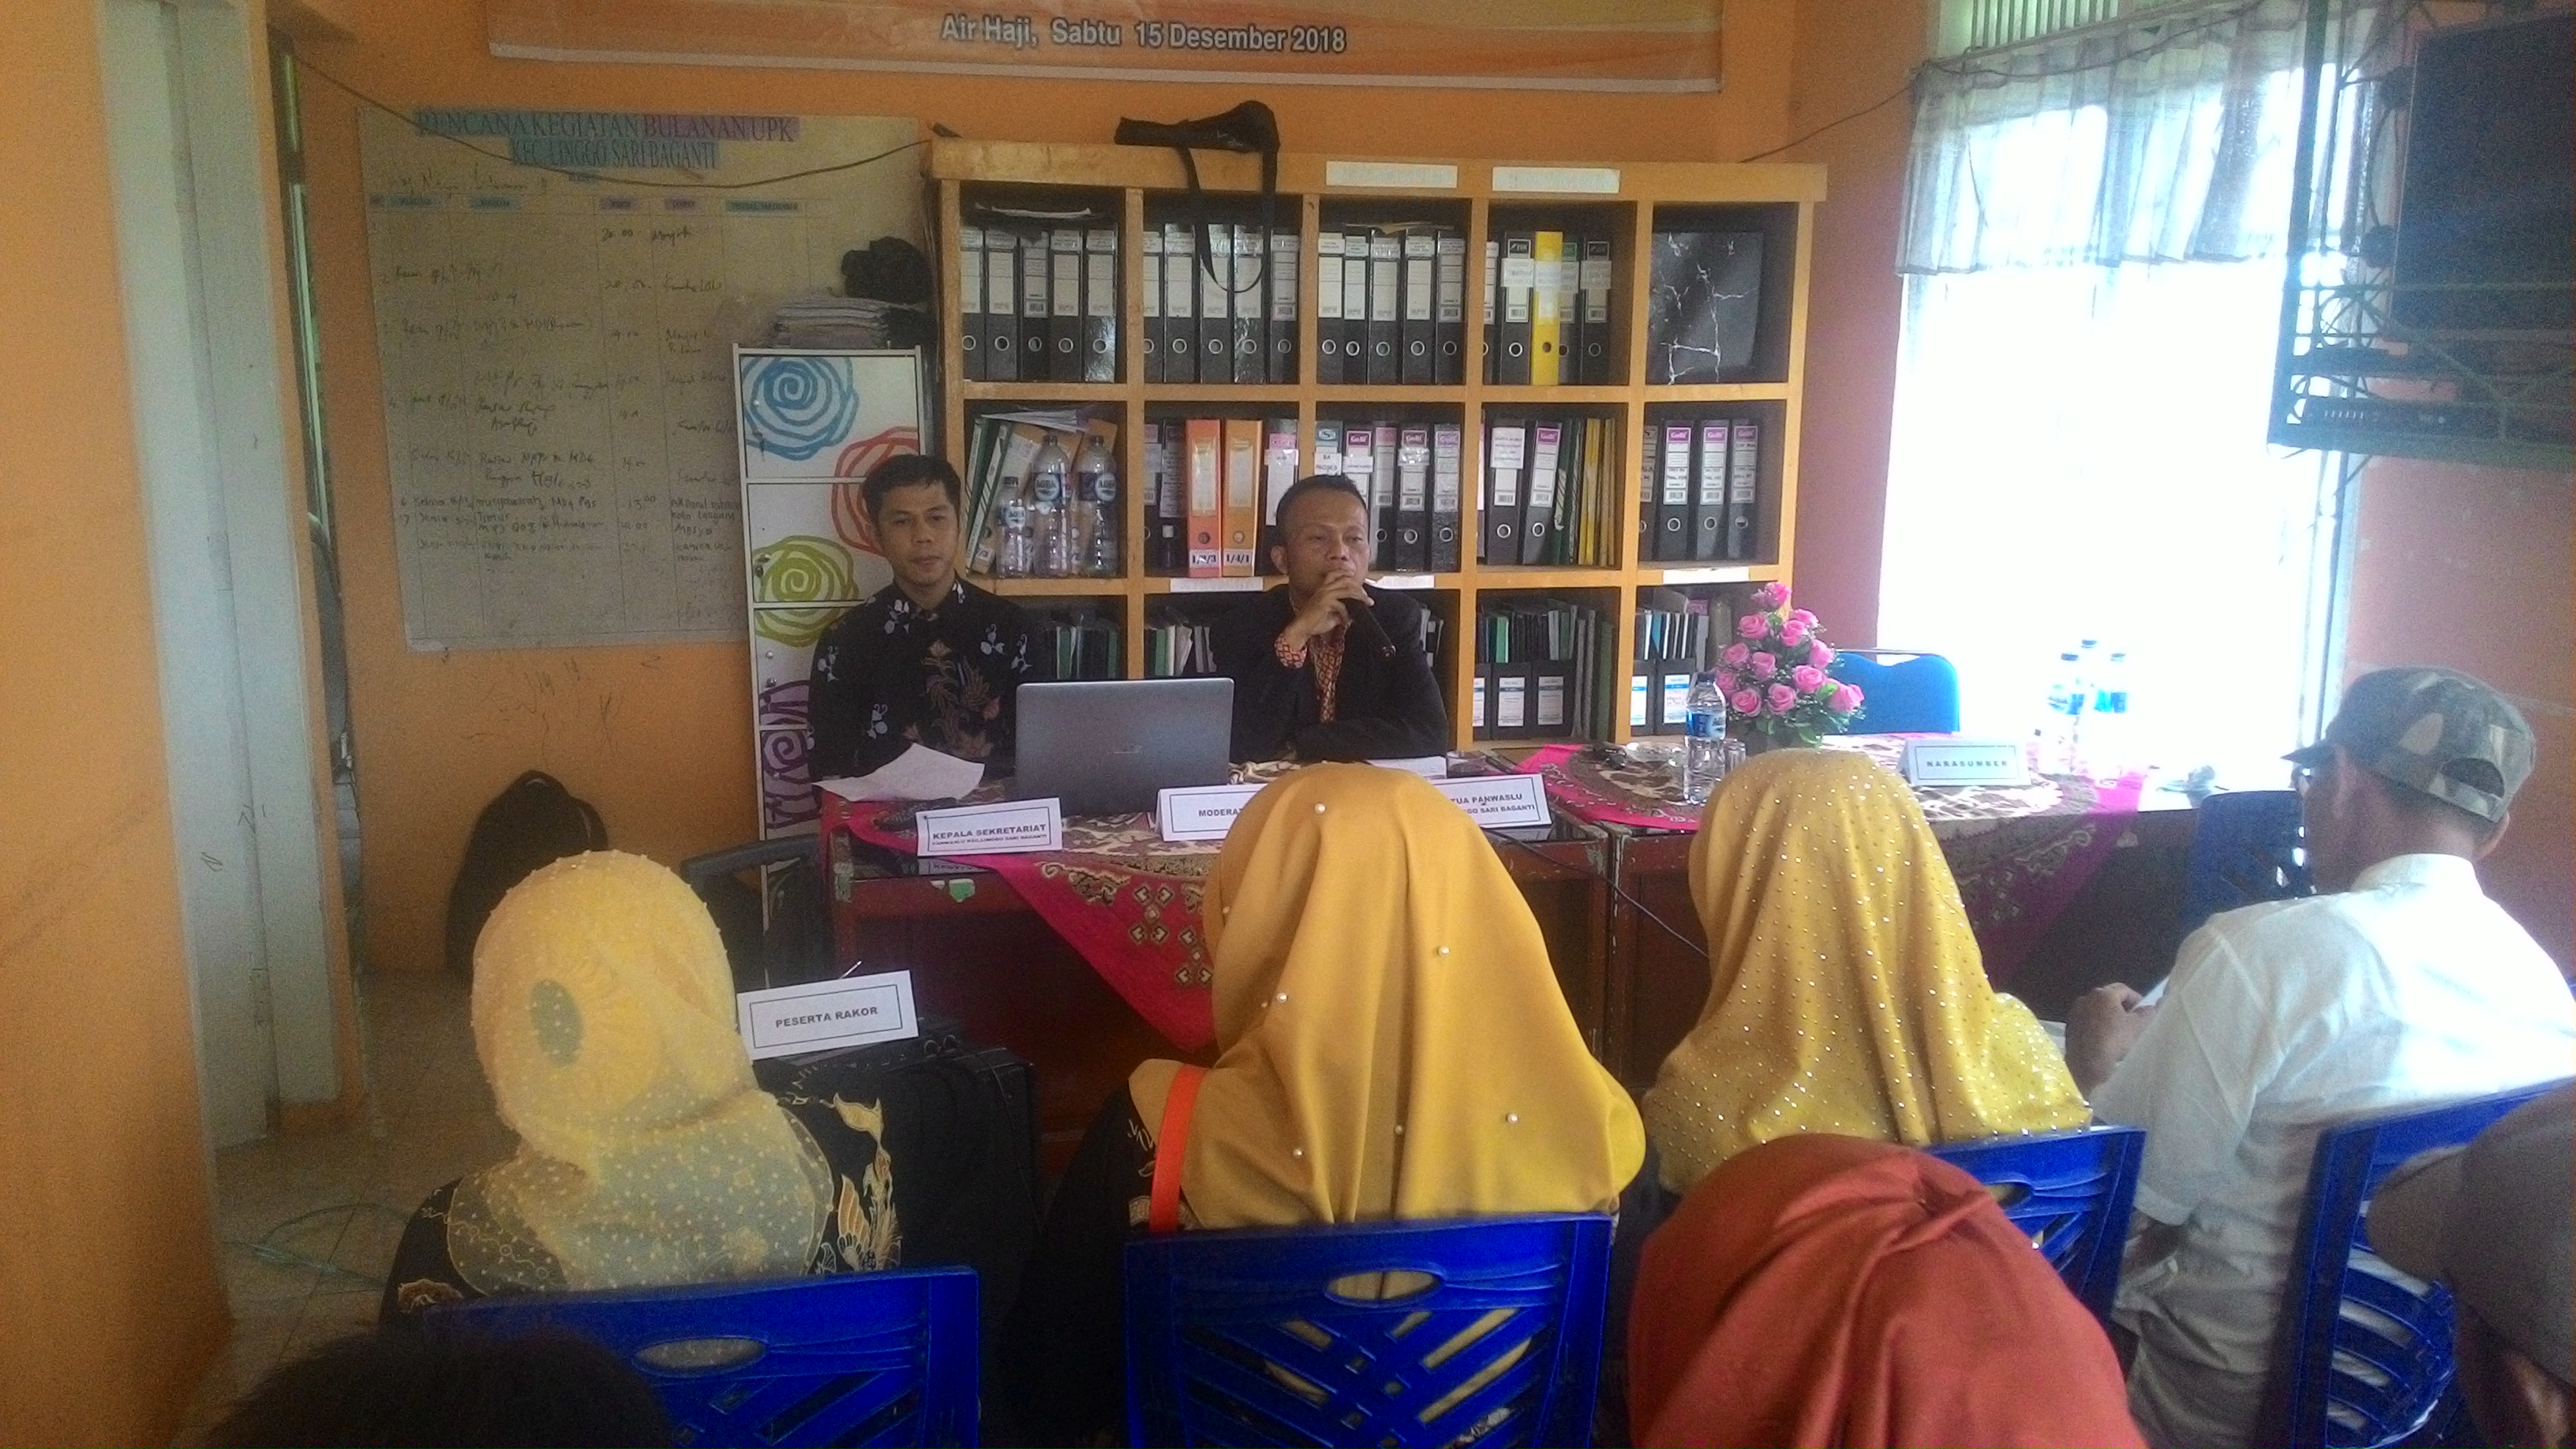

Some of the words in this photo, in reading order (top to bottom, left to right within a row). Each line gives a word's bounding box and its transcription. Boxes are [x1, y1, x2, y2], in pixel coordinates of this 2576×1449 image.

[942, 14, 975, 39] Air
[985, 16, 1037, 48] Haji,
[1051, 17, 1121, 46] Sabtu
[1135, 21, 1162, 47] 15
[1168, 21, 1287, 51] Desember
[1292, 26, 1346, 52] 2018
[532, 112, 639, 139] KEGIATAN
[643, 114, 747, 140] BULANAN
[751, 116, 795, 142] UPK
[612, 140, 646, 168] SARI
[650, 140, 717, 169] BAGANTI
[1472, 793, 1522, 804] PANWASLU
[1500, 803, 1536, 813] BAGANTI
[932, 829, 973, 841] KEPALA
[975, 823, 1047, 837] SEKRETARIAT
[775, 1012, 833, 1029] PESERTA
[834, 1005, 878, 1021] RAKOR
